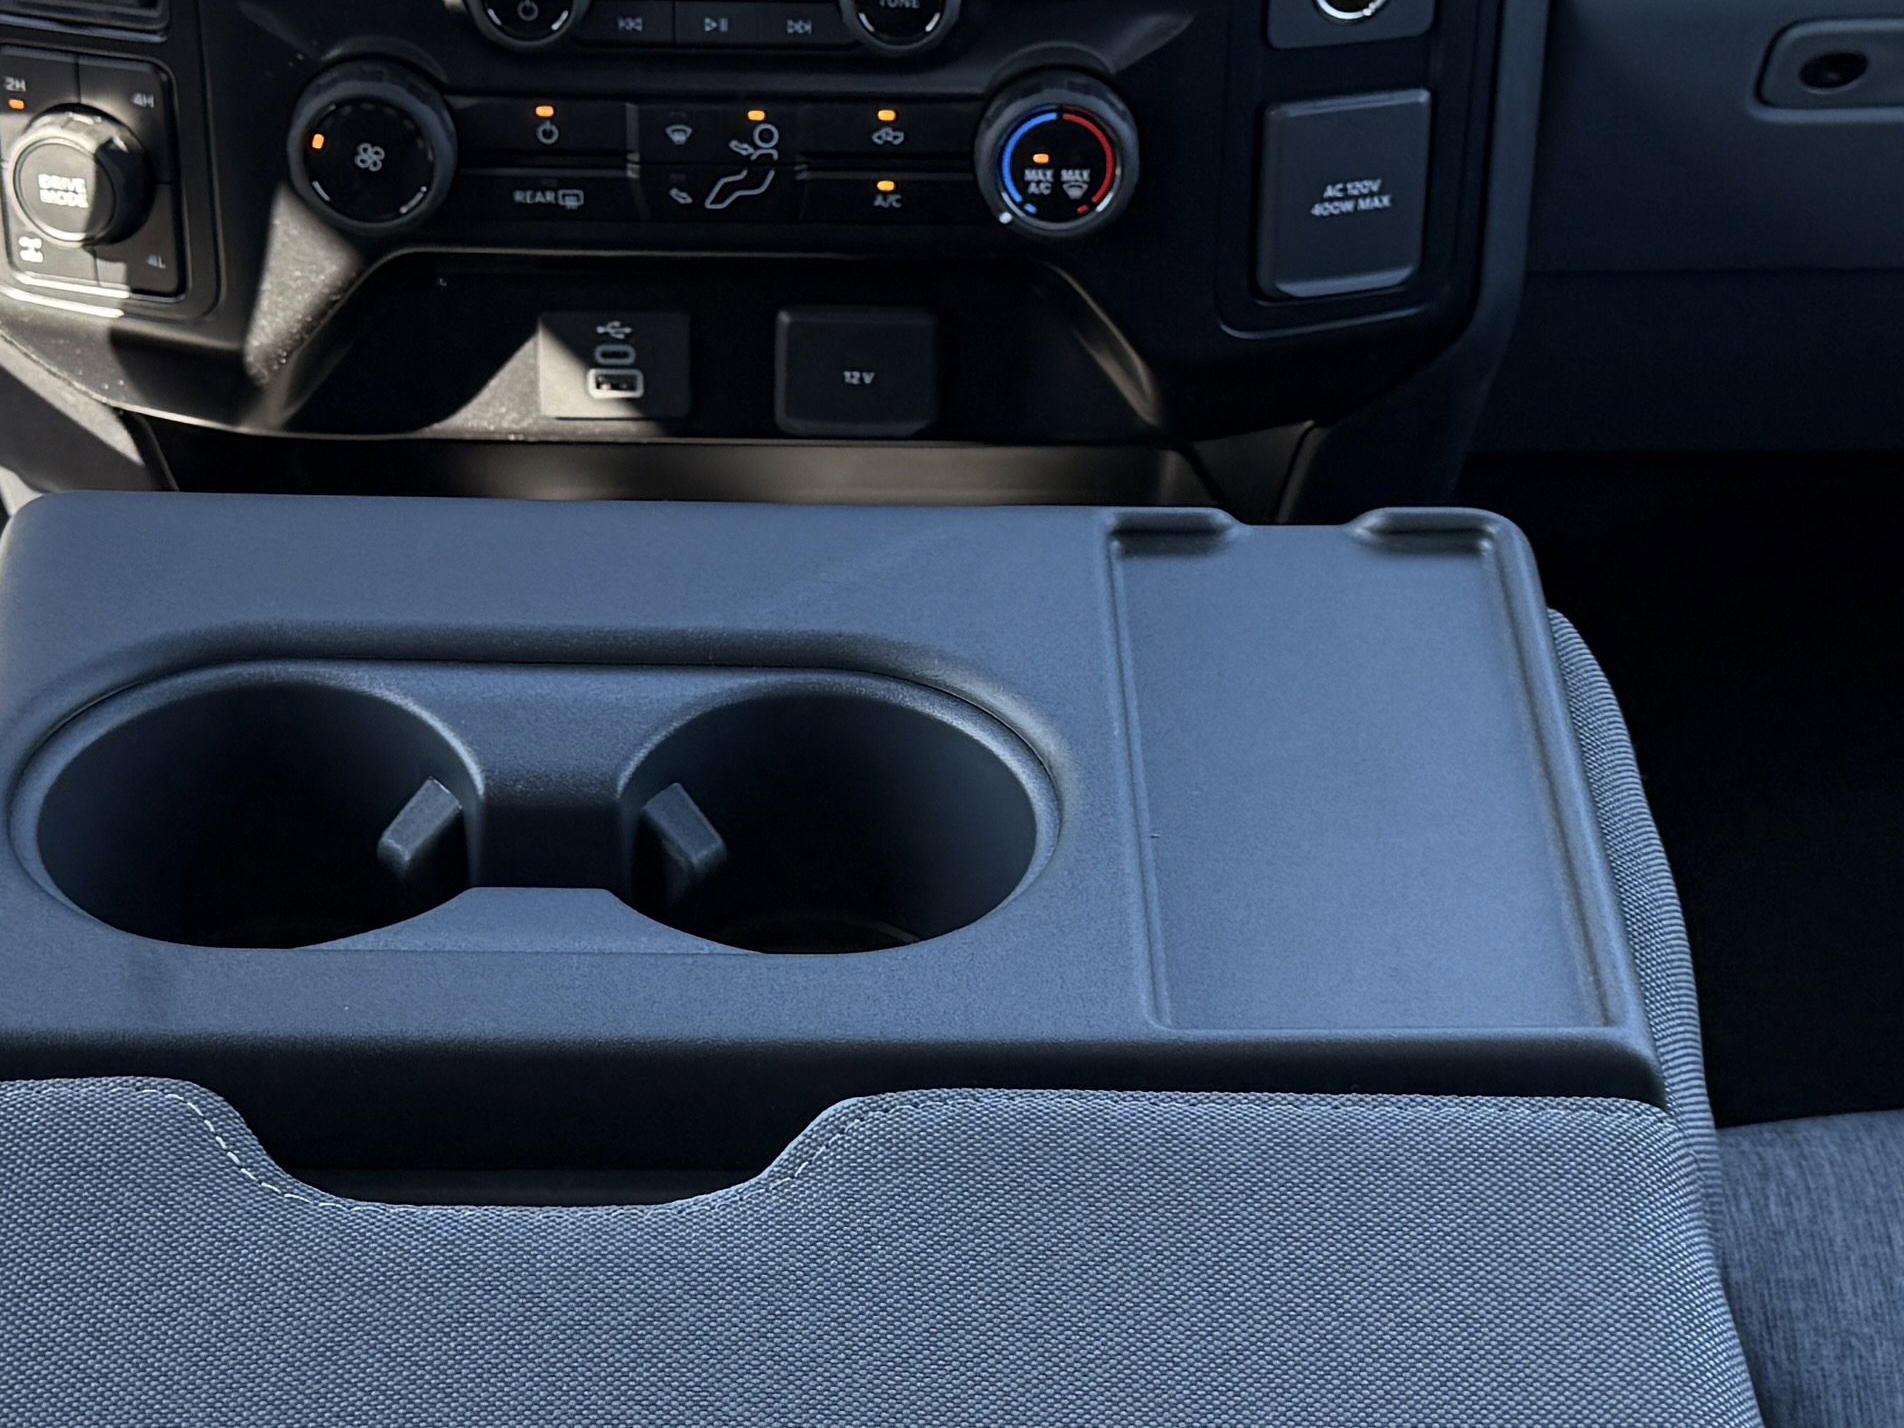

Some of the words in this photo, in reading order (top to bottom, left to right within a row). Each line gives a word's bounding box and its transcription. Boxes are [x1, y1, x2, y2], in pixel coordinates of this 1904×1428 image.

[2, 75, 26, 92] 2H
[131, 92, 154, 108] 4H
[38, 173, 86, 191] DRIVE
[1025, 168, 1055, 183] MAX
[1060, 168, 1090, 183] MAX
[1027, 181, 1052, 196] A/C
[1322, 182, 1345, 198] AC
[39, 189, 89, 209] MODE
[513, 189, 556, 205] REAR
[873, 194, 902, 209] A/C
[1357, 193, 1393, 211] MAX
[146, 254, 166, 269] 4L
